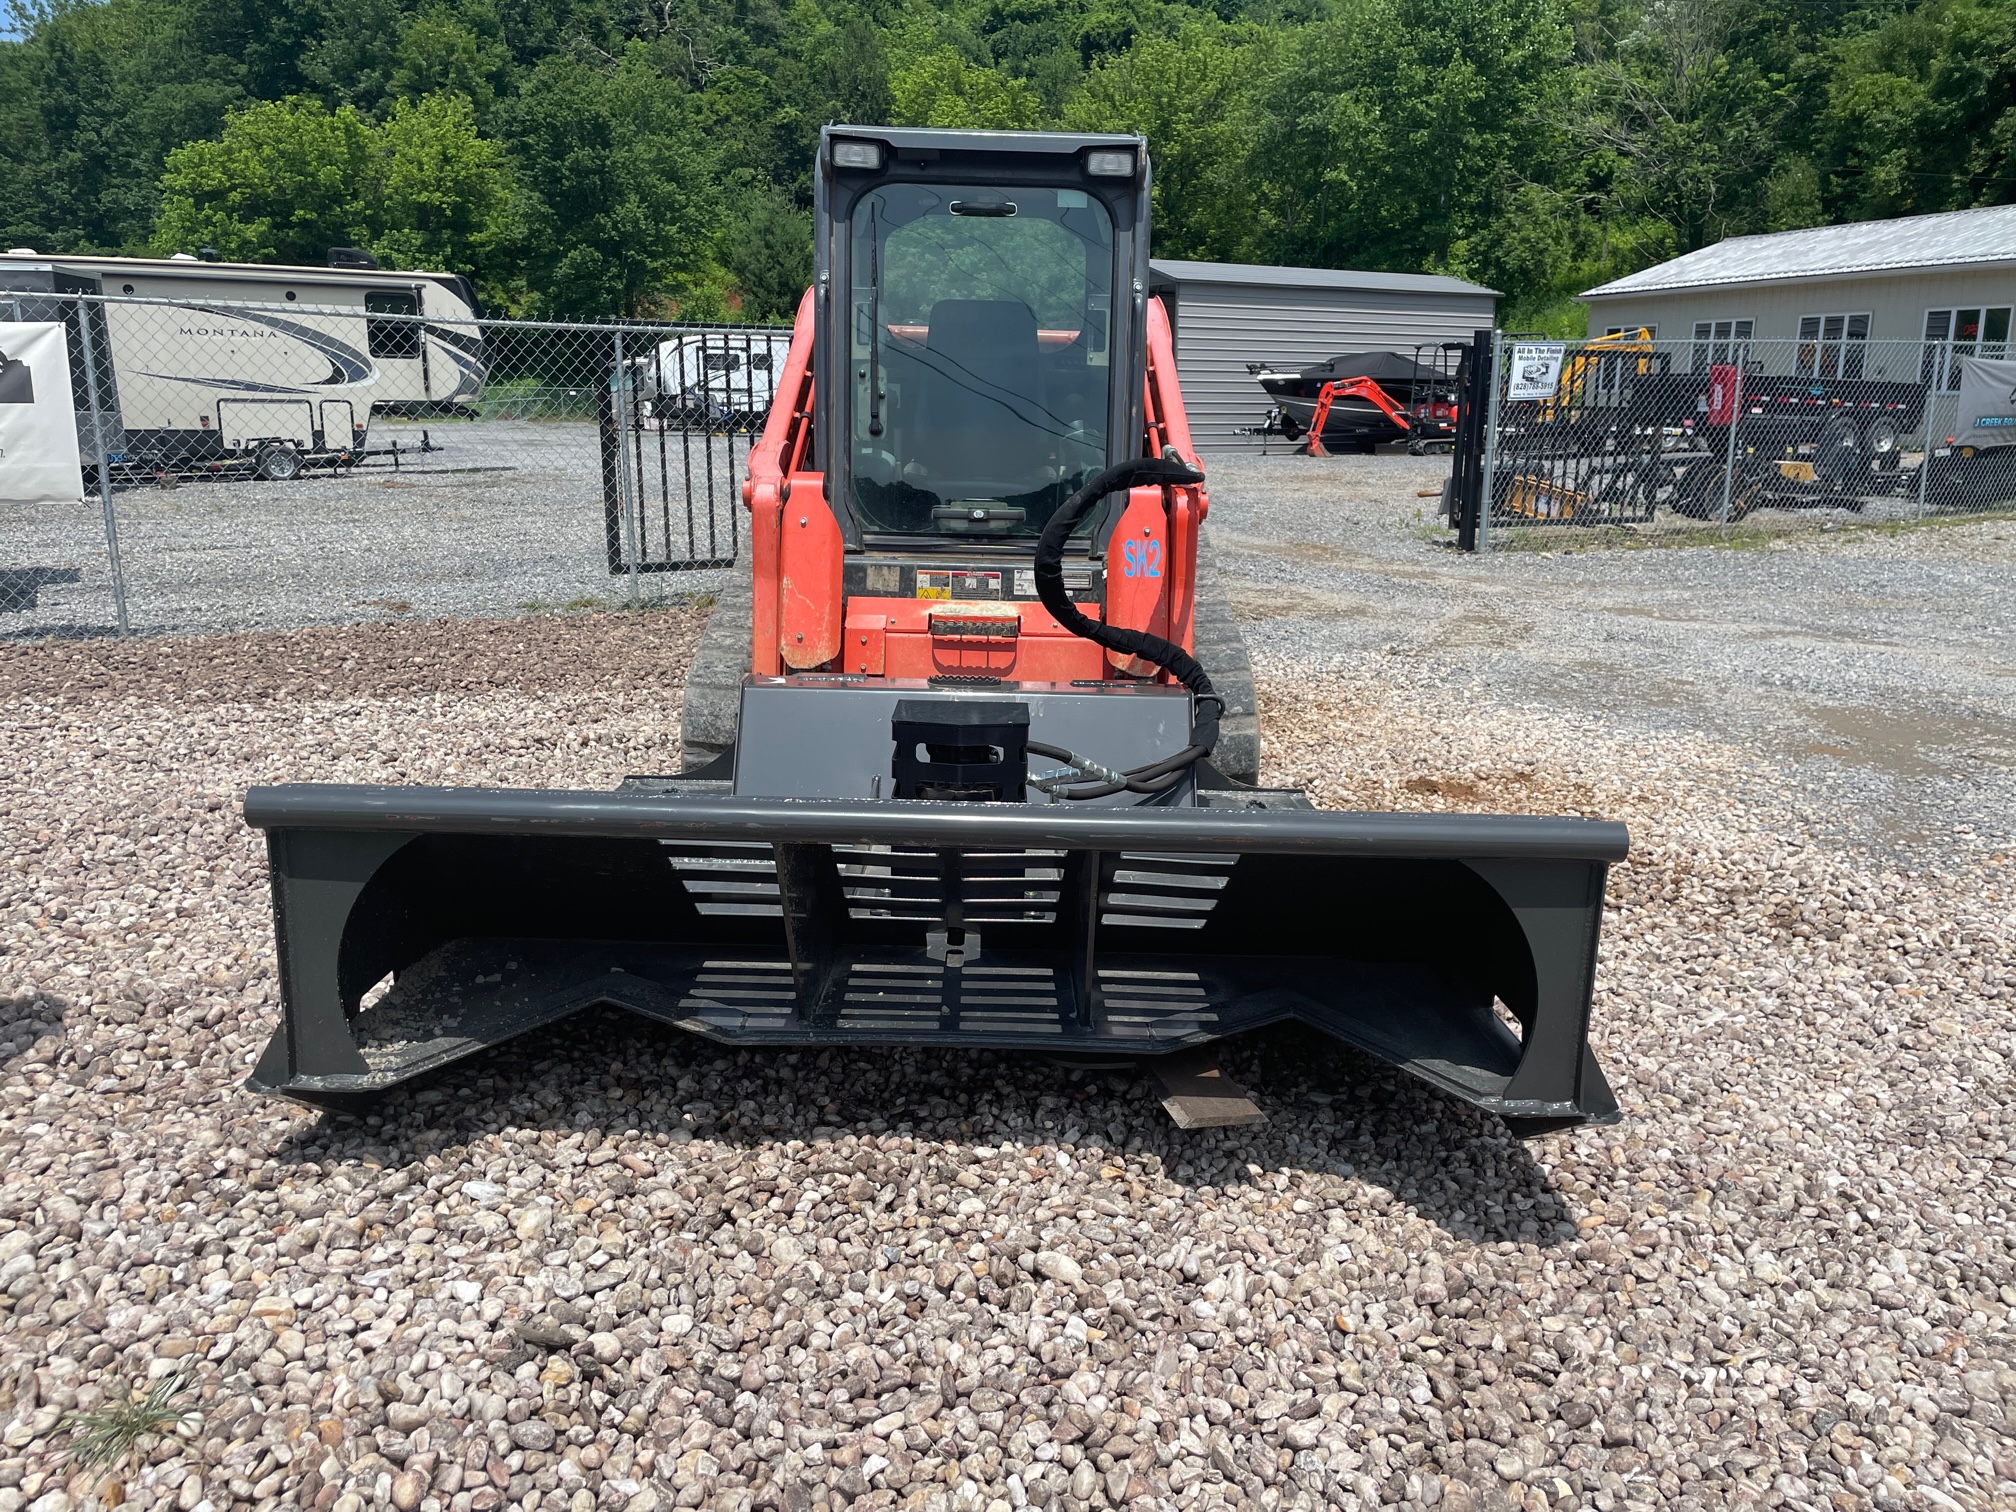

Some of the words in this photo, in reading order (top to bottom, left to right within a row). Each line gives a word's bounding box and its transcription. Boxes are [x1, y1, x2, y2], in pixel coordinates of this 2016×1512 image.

[179, 328, 278, 338] MONTANA
[1974, 418, 1980, 427] J
[1980, 418, 2003, 426] CREEK
[1124, 539, 1161, 577] SK2
